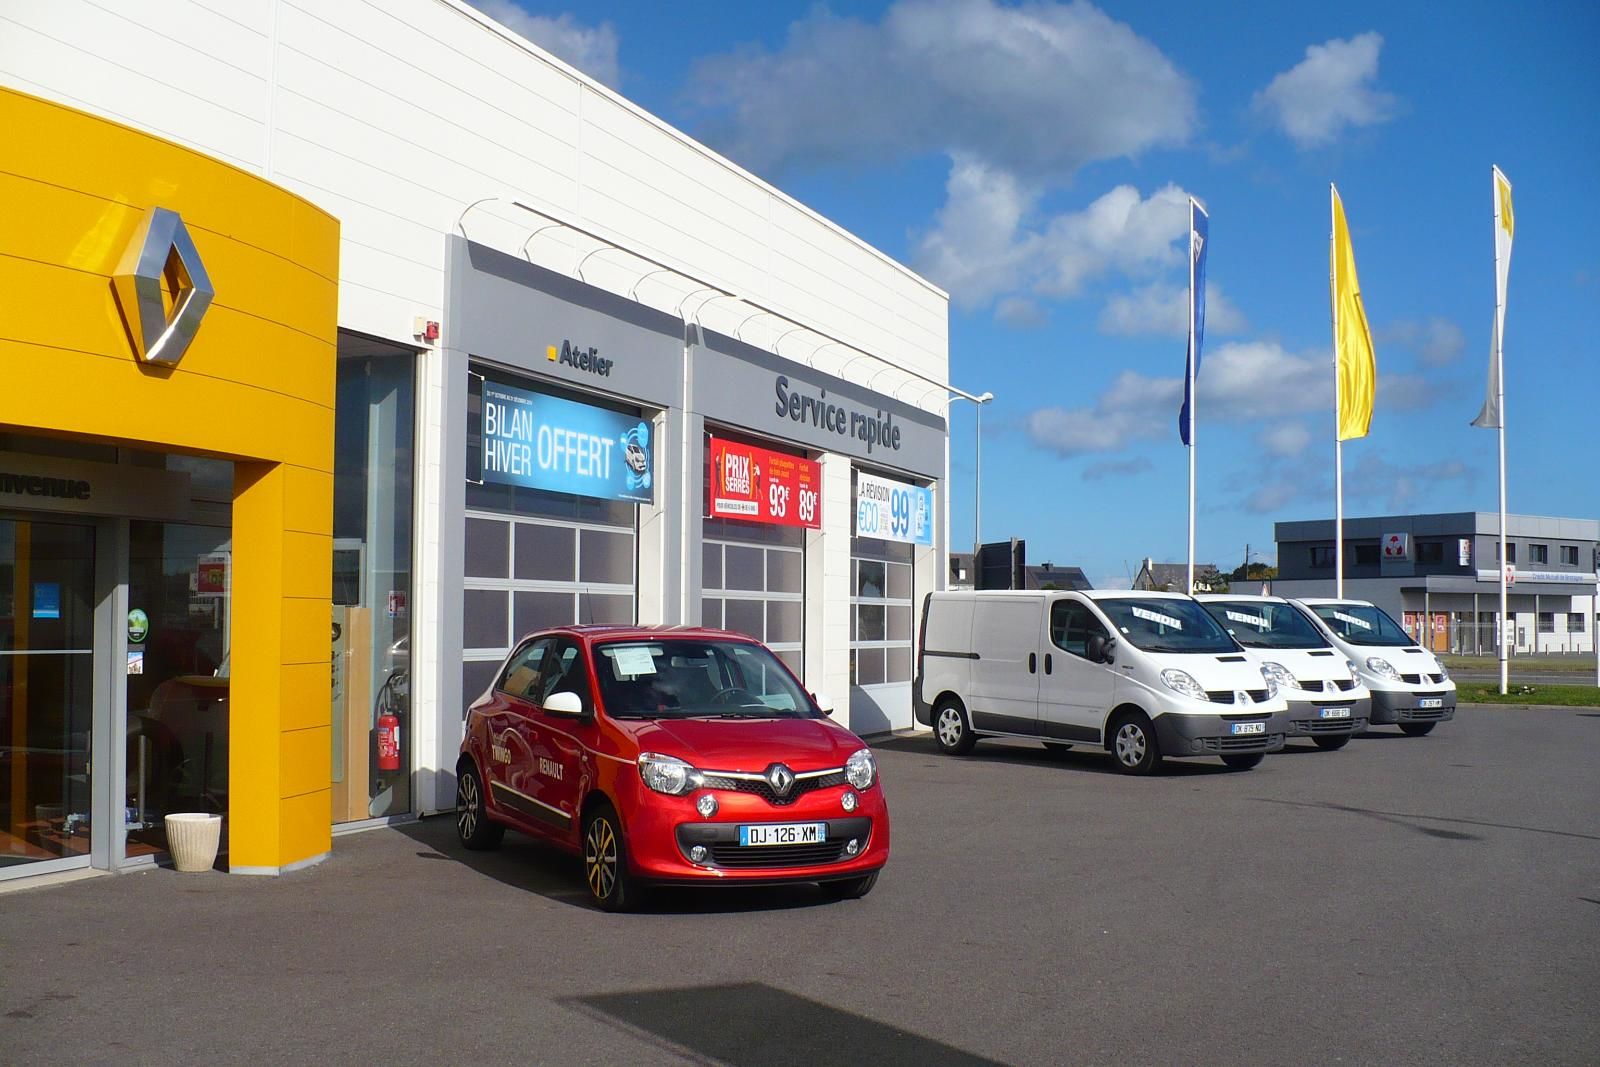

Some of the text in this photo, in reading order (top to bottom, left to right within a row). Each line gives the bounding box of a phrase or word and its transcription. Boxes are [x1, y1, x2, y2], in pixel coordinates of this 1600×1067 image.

[559, 339, 613, 377] Atelier
[485, 402, 533, 442] BILAN
[775, 375, 901, 454] Service rapide
[484, 438, 532, 476] HIVER
[537, 425, 614, 479] OFFERT
[725, 453, 750, 481] PRIX
[891, 487, 909, 537] 99
[1132, 606, 1182, 630] VENDU
[1225, 610, 1269, 628] VENDU
[1333, 611, 1371, 630] VENDU
[539, 757, 564, 781] RENAULT
